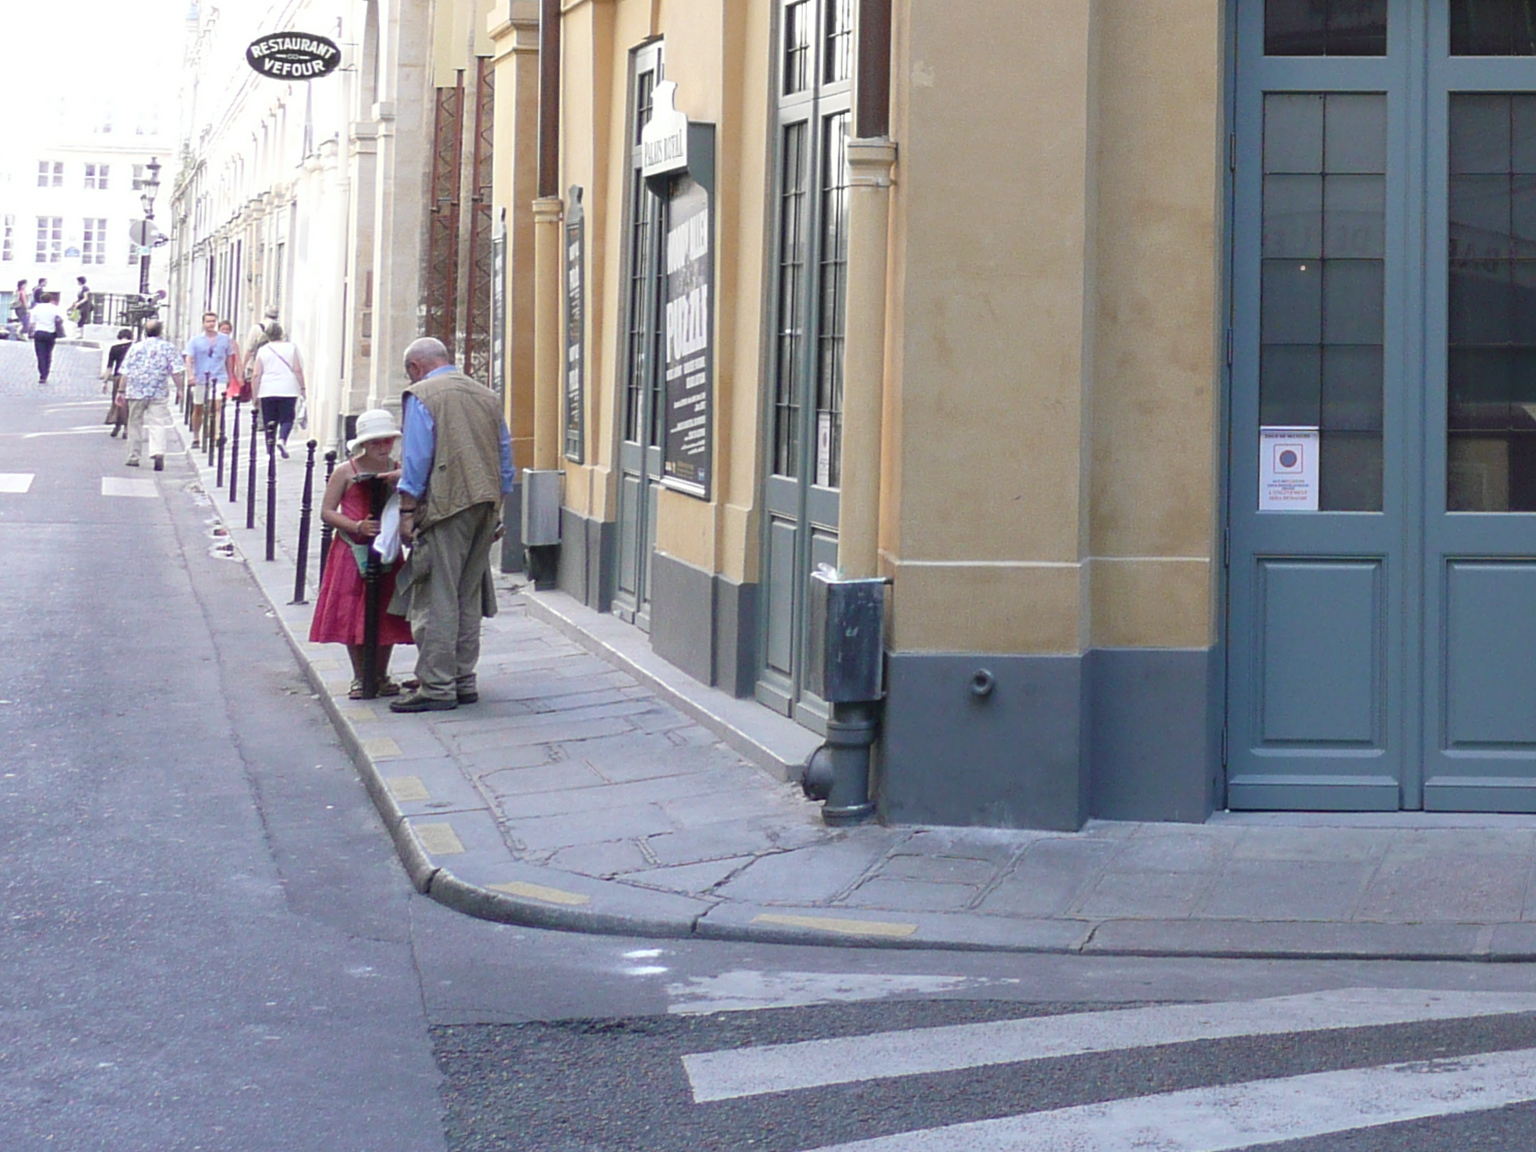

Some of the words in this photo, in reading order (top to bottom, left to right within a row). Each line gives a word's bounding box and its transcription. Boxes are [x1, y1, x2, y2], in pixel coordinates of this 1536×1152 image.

[250, 37, 336, 59] RESTAURANT
[263, 58, 326, 76] VEFOUR
[666, 283, 708, 363] PUZZLE
